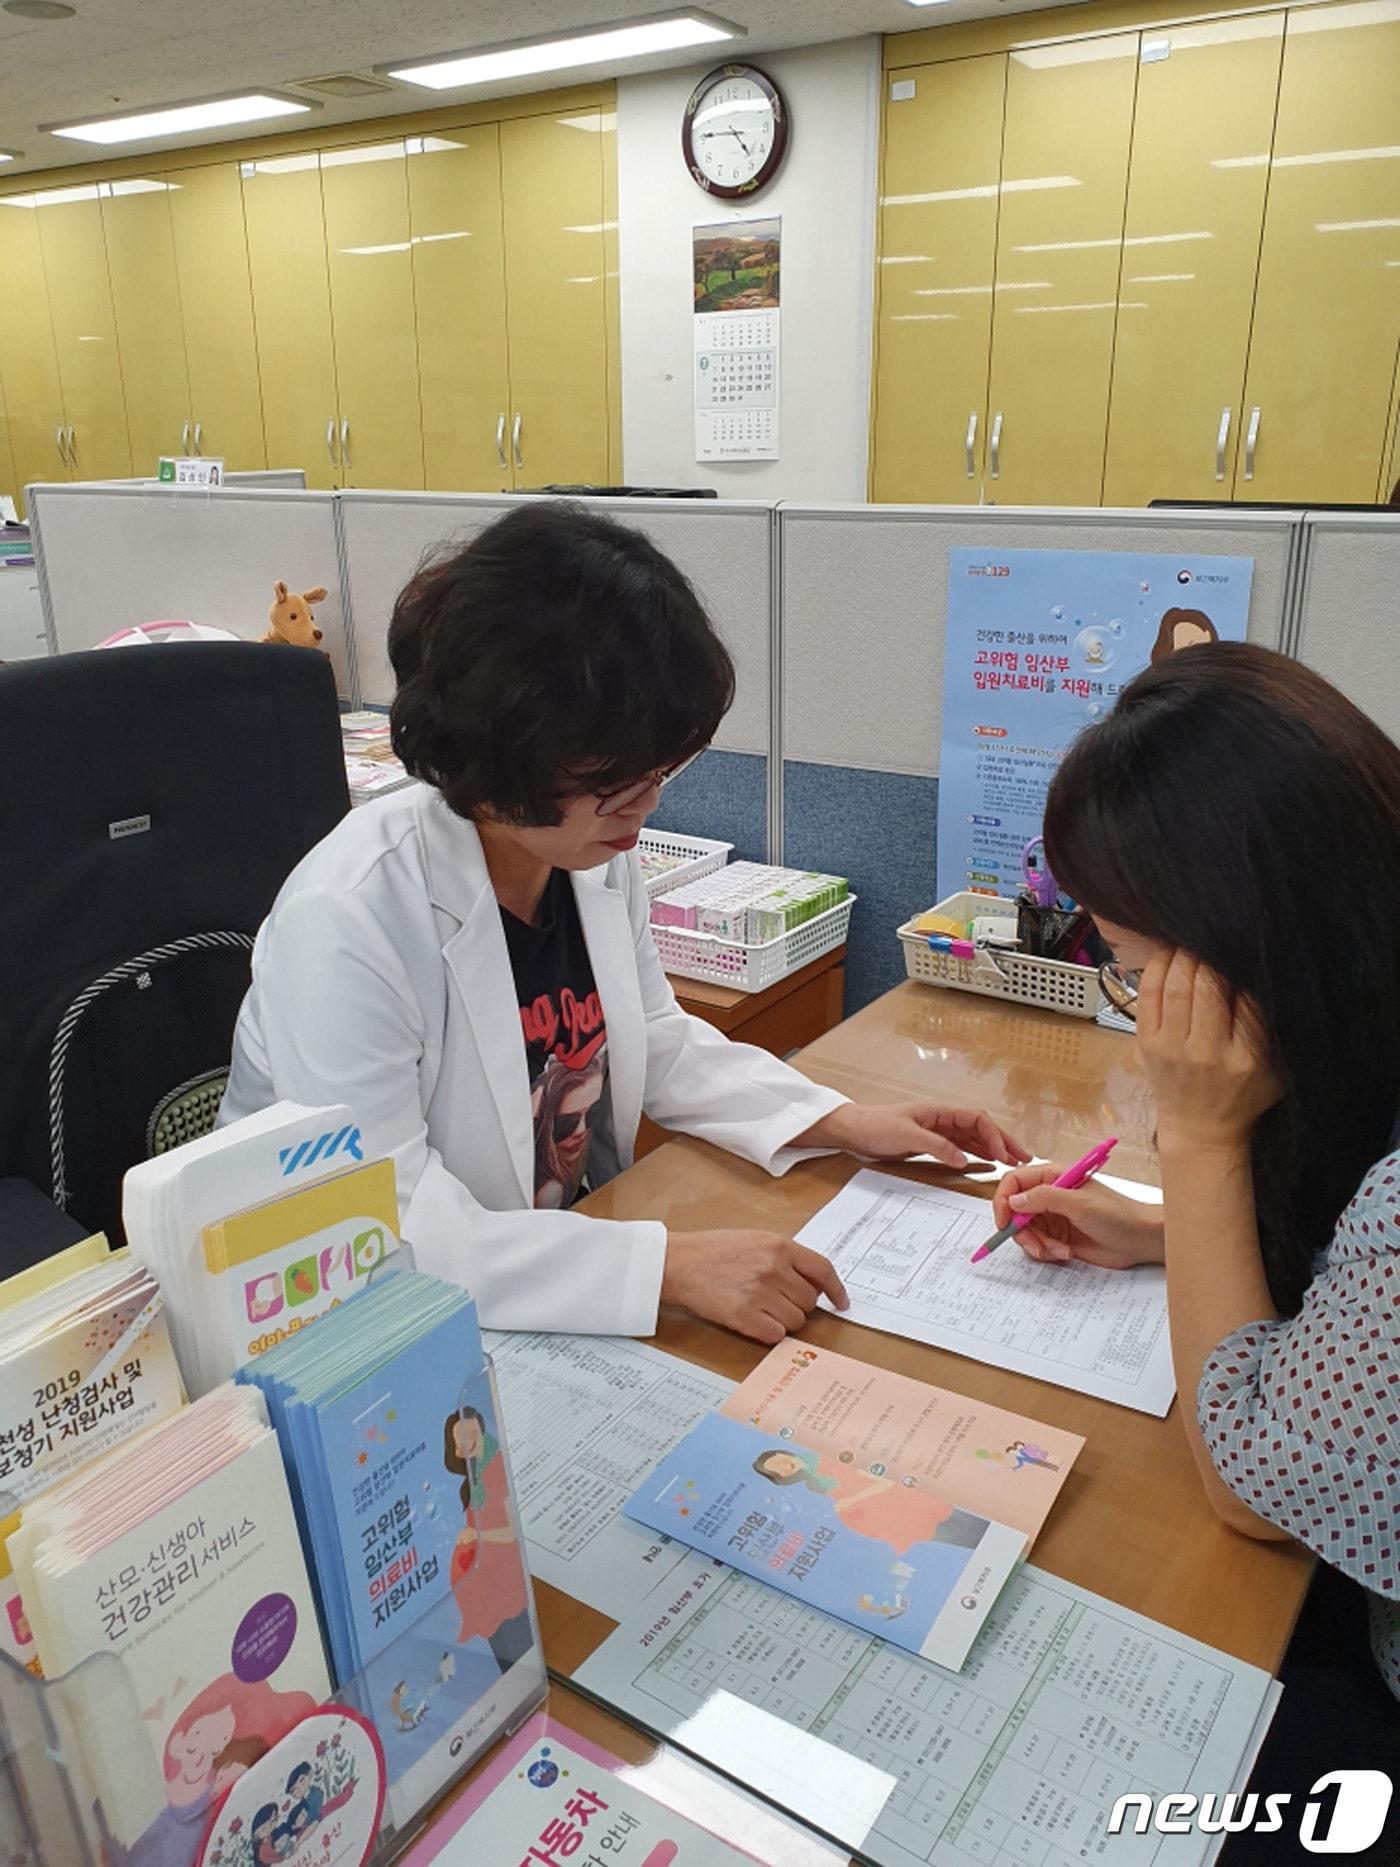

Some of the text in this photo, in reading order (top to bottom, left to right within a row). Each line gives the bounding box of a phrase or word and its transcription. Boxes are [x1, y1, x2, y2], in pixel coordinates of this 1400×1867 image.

[974, 651, 1070, 673] 고위험 임산부
[1038, 634, 1067, 645] 위하여
[974, 672, 1056, 693] 입원치료비를
[1061, 679, 1103, 698] 지원해
[33, 1369, 81, 1408] 2019
[41, 1372, 120, 1429] 난청검사
[123, 1358, 144, 1382] 및
[59, 1387, 135, 1441] 지원사업
[361, 1494, 411, 1552] 고위험
[727, 1512, 768, 1551] 고위험
[95, 1517, 209, 1610] 산모·신생아
[364, 1523, 414, 1580] 임산부
[369, 1546, 418, 1602] 의료비
[768, 1532, 806, 1572] 의료비
[788, 1526, 836, 1582] 지원사업
[101, 1555, 200, 1641] 건강관리
[200, 1517, 257, 1569] 서비스
[373, 1554, 439, 1629] 지원사업
[639, 1616, 668, 1647] 2019년
[600, 1811, 641, 1853] 안내
